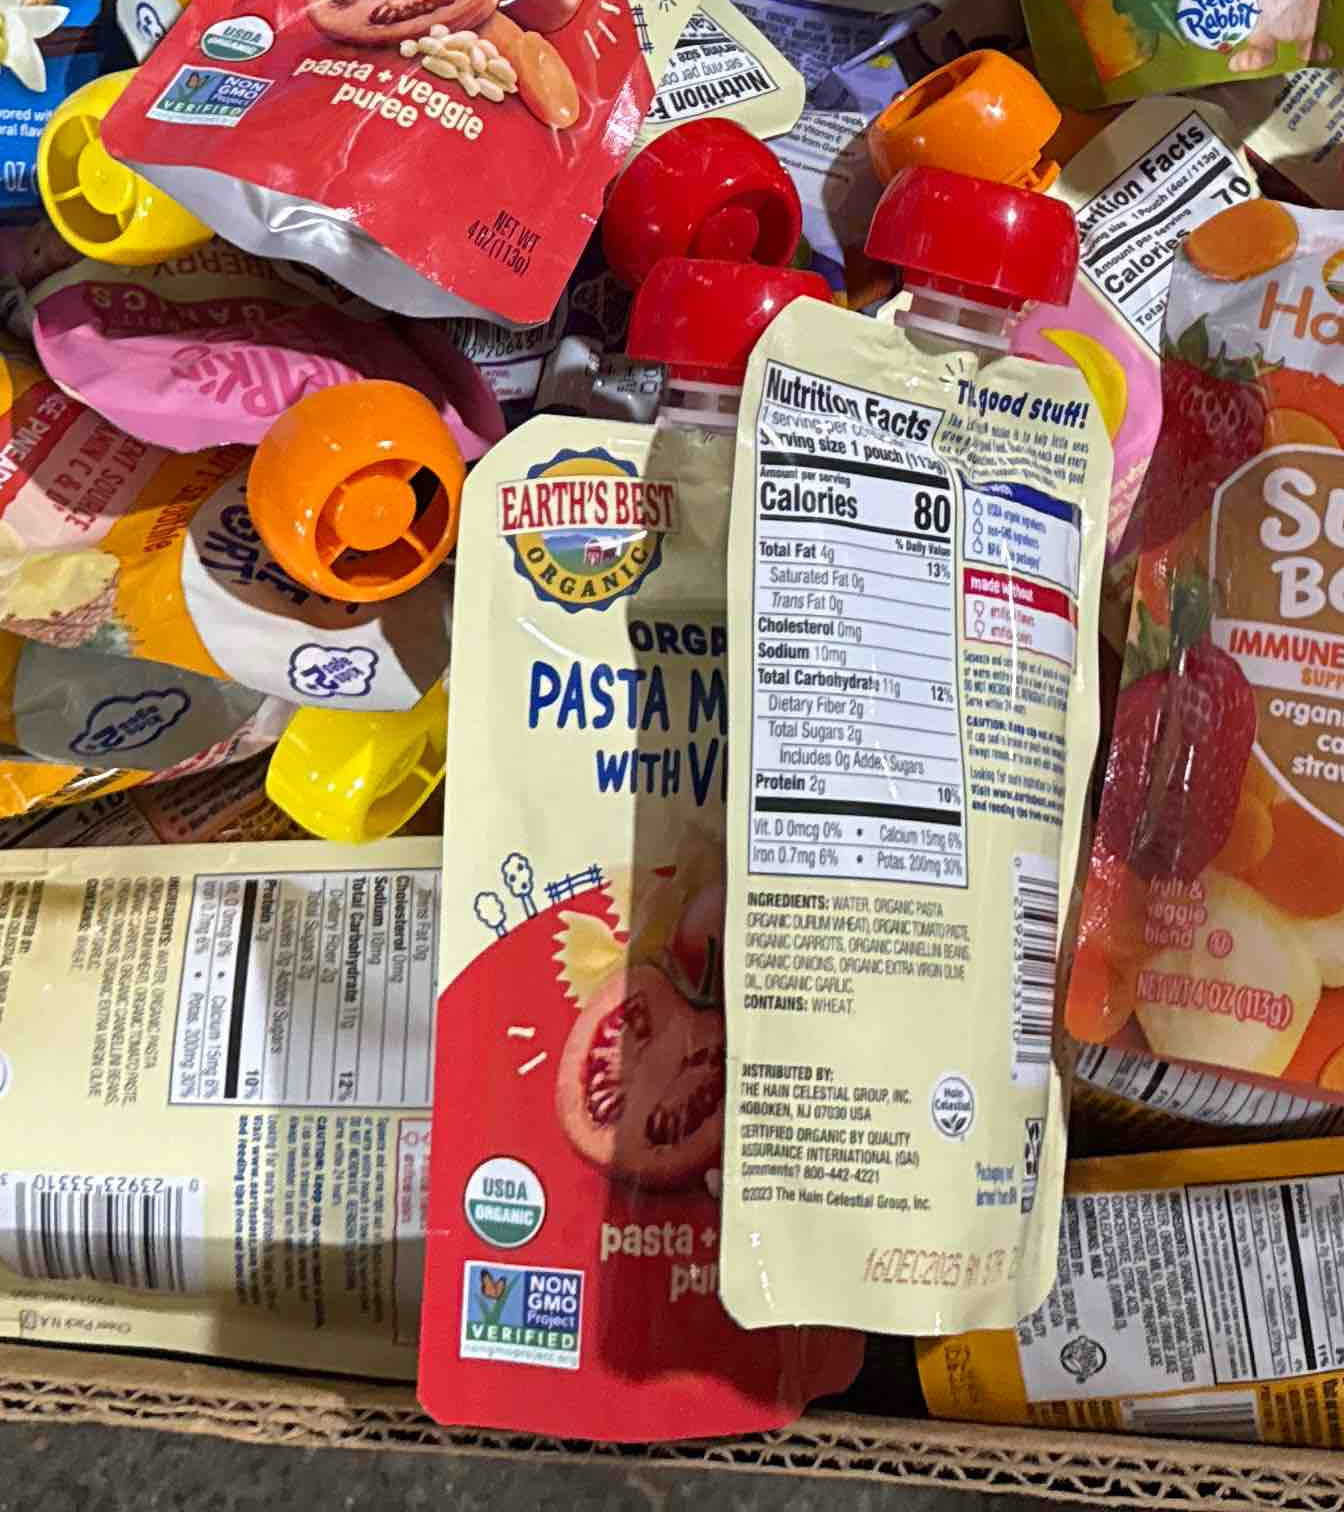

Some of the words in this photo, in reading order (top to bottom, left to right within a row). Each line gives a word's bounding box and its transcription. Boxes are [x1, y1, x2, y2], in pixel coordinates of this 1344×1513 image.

[1176, 4, 1259, 38] Rabbit
[293, 57, 373, 82] pasta
[396, 72, 484, 141] veggie
[331, 83, 419, 128] puree
[766, 367, 859, 419] Nutrition
[865, 398, 932, 442] Facts
[1030, 400, 1089, 428] stuff!
[864, 446, 904, 466] pouch
[501, 482, 608, 531] EARTH'S
[616, 482, 673, 529] BEST
[760, 481, 858, 519] Calories
[914, 492, 951, 534] 80
[527, 544, 649, 598] ORGANIC
[770, 567, 828, 586] Saturated
[758, 643, 809, 660] Sodium
[528, 660, 669, 730] PASTA
[768, 694, 812, 716] Dietary
[817, 696, 846, 714] Fiber
[596, 750, 681, 797] WITH
[756, 774, 806, 791] Protein
[482, 1177, 527, 1200] USDA
[600, 1222, 693, 1261] pasta
[530, 1275, 577, 1295] NON
[527, 1293, 577, 1313] GMO
[472, 1324, 575, 1349] VERIFIED
